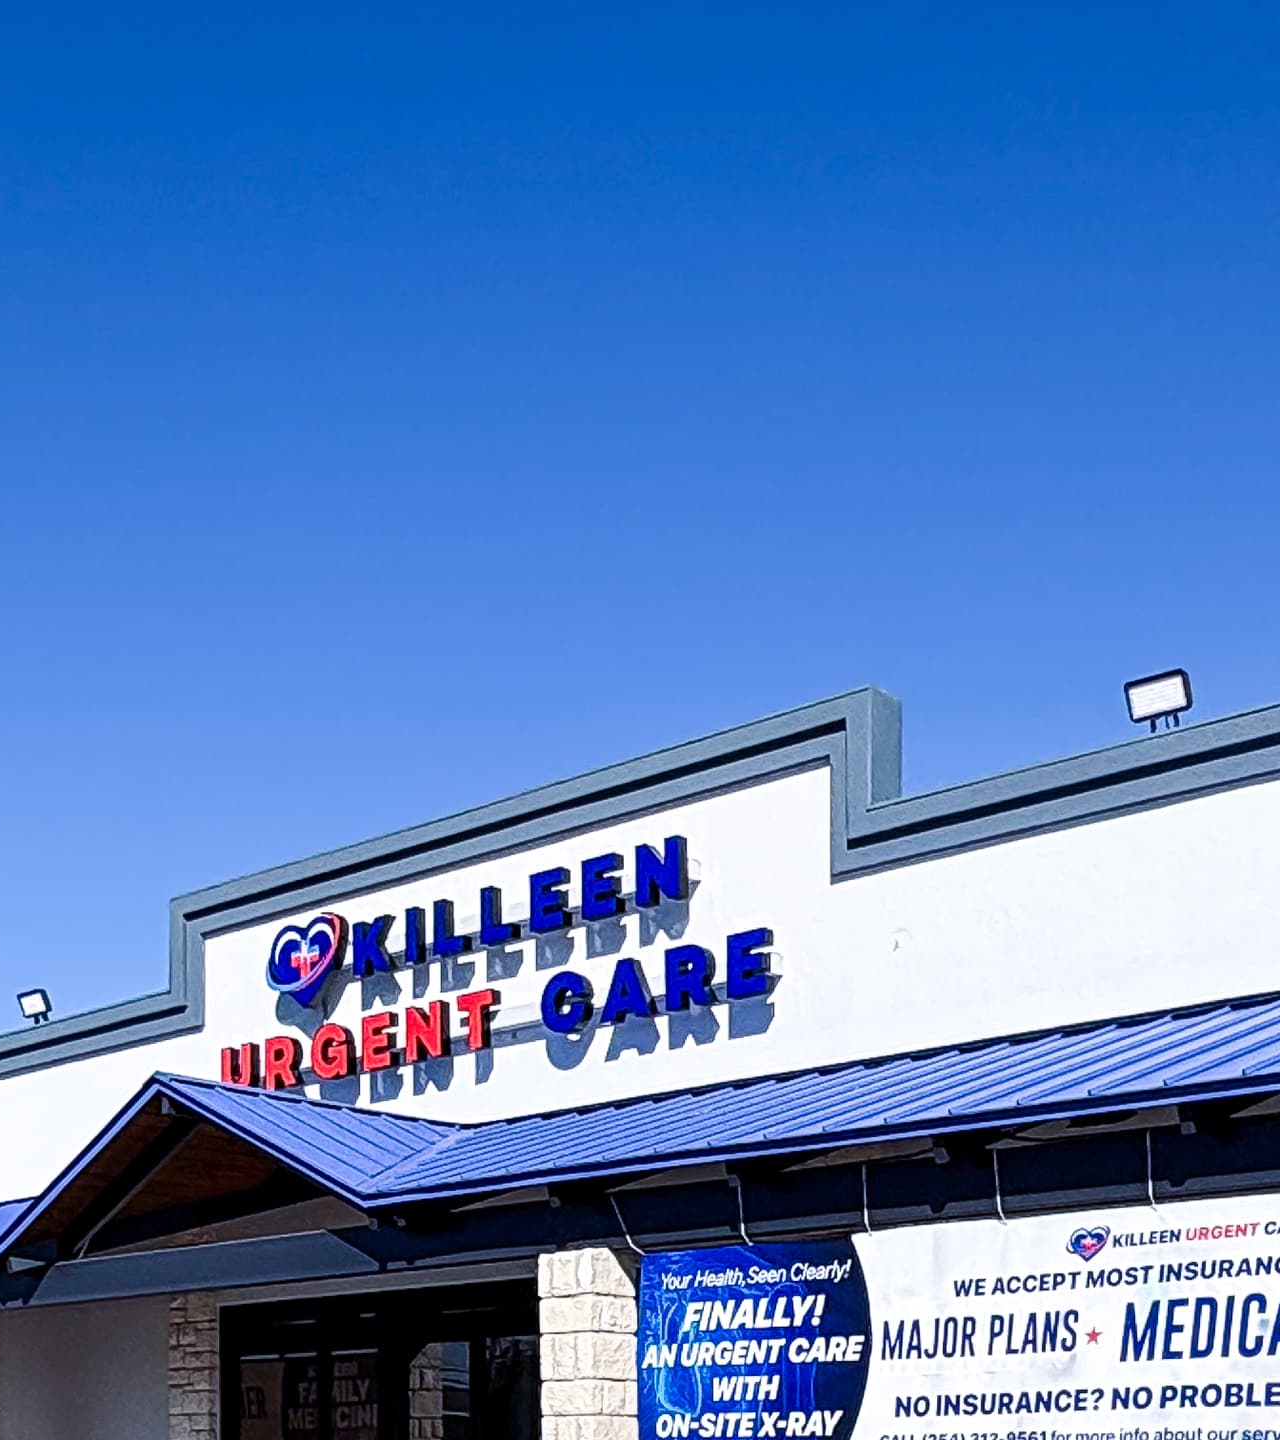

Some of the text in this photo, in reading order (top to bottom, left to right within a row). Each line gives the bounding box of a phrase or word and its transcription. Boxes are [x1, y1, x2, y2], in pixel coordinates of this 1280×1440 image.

[353, 835, 688, 978] KILLEEN
[221, 926, 776, 1090] URGENT CARE
[1112, 1228, 1182, 1249] KILLEEN
[1186, 1222, 1260, 1242] URGENT
[661, 1259, 852, 1290] Your Health, Seen Clearly!
[954, 1277, 986, 1298] WE
[992, 1271, 1081, 1295] ACCEPT
[1085, 1264, 1155, 1289] MOST
[681, 1294, 826, 1332] FINALLY!
[641, 1335, 865, 1369] AN URGENT CARE
[881, 1315, 976, 1361] MAJOR
[987, 1309, 1080, 1356] PLANS
[712, 1374, 780, 1401] WITH
[894, 1395, 930, 1418] NO
[936, 1387, 1105, 1416] INSURANCE?
[1111, 1387, 1153, 1410] NO
[655, 1410, 844, 1439] ON-SITE X-RAY
